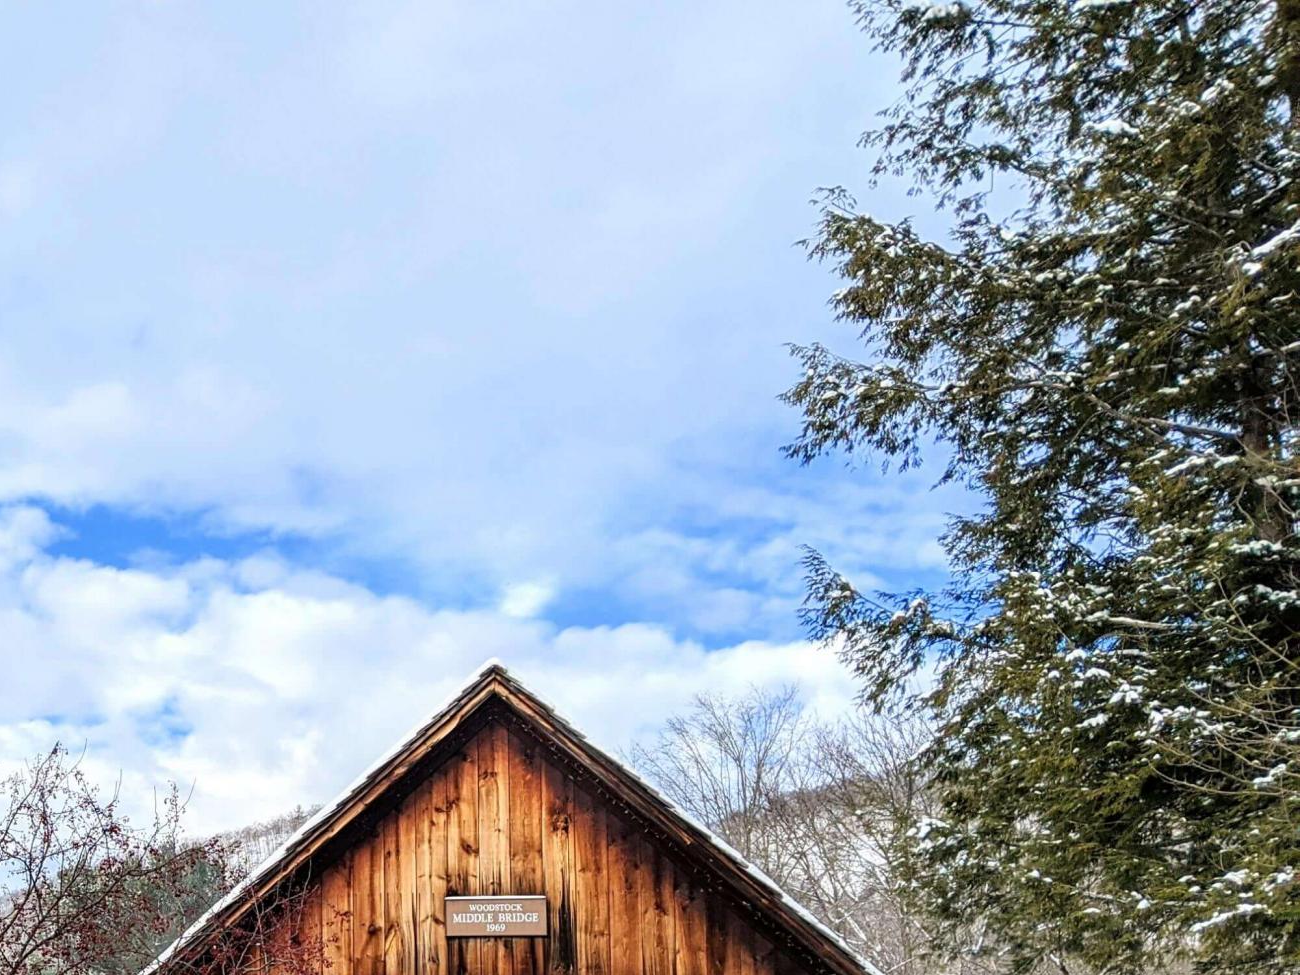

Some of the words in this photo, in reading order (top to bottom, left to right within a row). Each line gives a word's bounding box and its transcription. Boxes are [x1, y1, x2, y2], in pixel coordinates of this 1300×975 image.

[469, 903, 523, 912] WOODSTOCK
[452, 913, 494, 923] MIDDLE
[498, 912, 539, 922] BRIDGE
[486, 923, 506, 932] 1969
